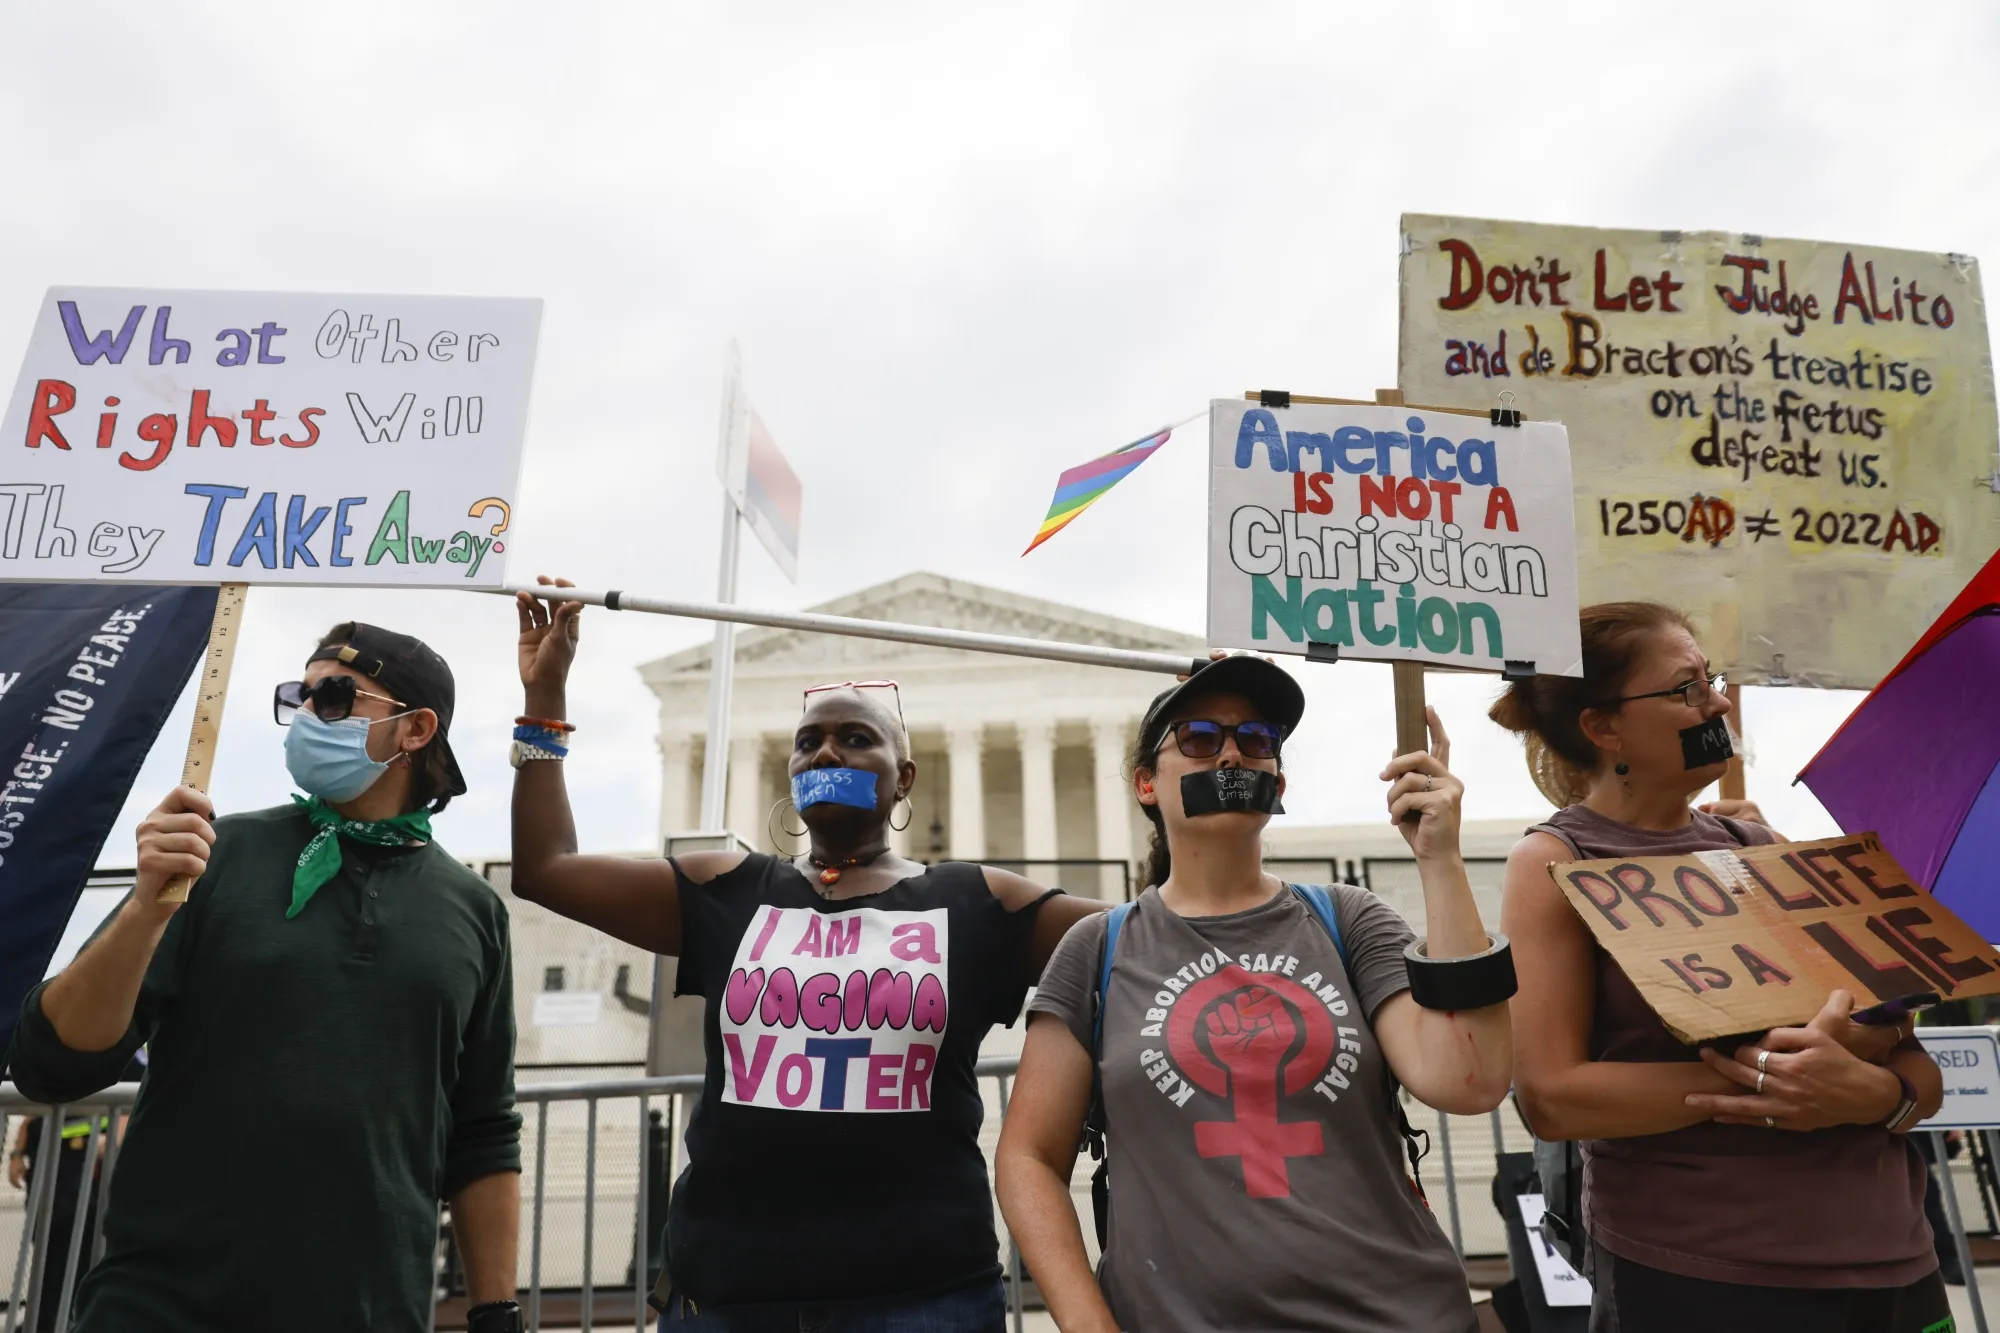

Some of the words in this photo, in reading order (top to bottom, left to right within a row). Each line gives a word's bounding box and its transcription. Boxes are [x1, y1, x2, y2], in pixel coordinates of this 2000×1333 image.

[1438, 238, 1571, 311] Don't
[1594, 247, 1685, 312] Let
[1714, 253, 1820, 337] Judge
[57, 300, 287, 366] What
[316, 309, 500, 363] Other
[1445, 328, 1511, 378] and
[1518, 324, 1556, 377] de
[1561, 309, 1754, 381] Bracton's
[1762, 337, 1932, 395] treatise
[25, 378, 327, 471] Rights
[346, 392, 482, 444] Will
[1651, 388, 1702, 418] on
[1713, 380, 1767, 423] the
[1773, 389, 1887, 442] fetus
[1234, 408, 1500, 487] America
[1691, 411, 1821, 482] defeat
[1838, 450, 1888, 488] us.
[0, 483, 164, 573] They
[184, 483, 367, 570] TAKE
[365, 490, 511, 577] Away?
[1294, 471, 1333, 515] IS
[1360, 475, 1461, 524] NOT
[1484, 487, 1519, 532] A
[1229, 505, 1548, 597] Christian
[211, 669, 218, 678] 10
[215, 649, 222, 657] 11
[220, 627, 227, 636] 12
[224, 607, 231, 616] 13
[228, 587, 235, 596] 14
[1251, 576, 1504, 659] Nation
[41, 689, 94, 730] NO
[1216, 769, 1255, 782] SECOND
[1218, 790, 1253, 801] CITIZEN
[1222, 780, 1247, 790] CLASS
[1566, 862, 1740, 932] PRO
[748, 907, 783, 962] I
[791, 913, 862, 958] AM
[889, 921, 941, 964] a
[1239, 953, 1300, 977] SAFE
[1660, 953, 1733, 994] IS
[1731, 943, 1795, 987] A
[725, 966, 947, 1035] VAGINA
[1300, 971, 1350, 1017] AND
[723, 1033, 938, 1111] VOTER
[1140, 1048, 1196, 1108] KEEP
[1313, 1026, 1362, 1102] LEGAL
